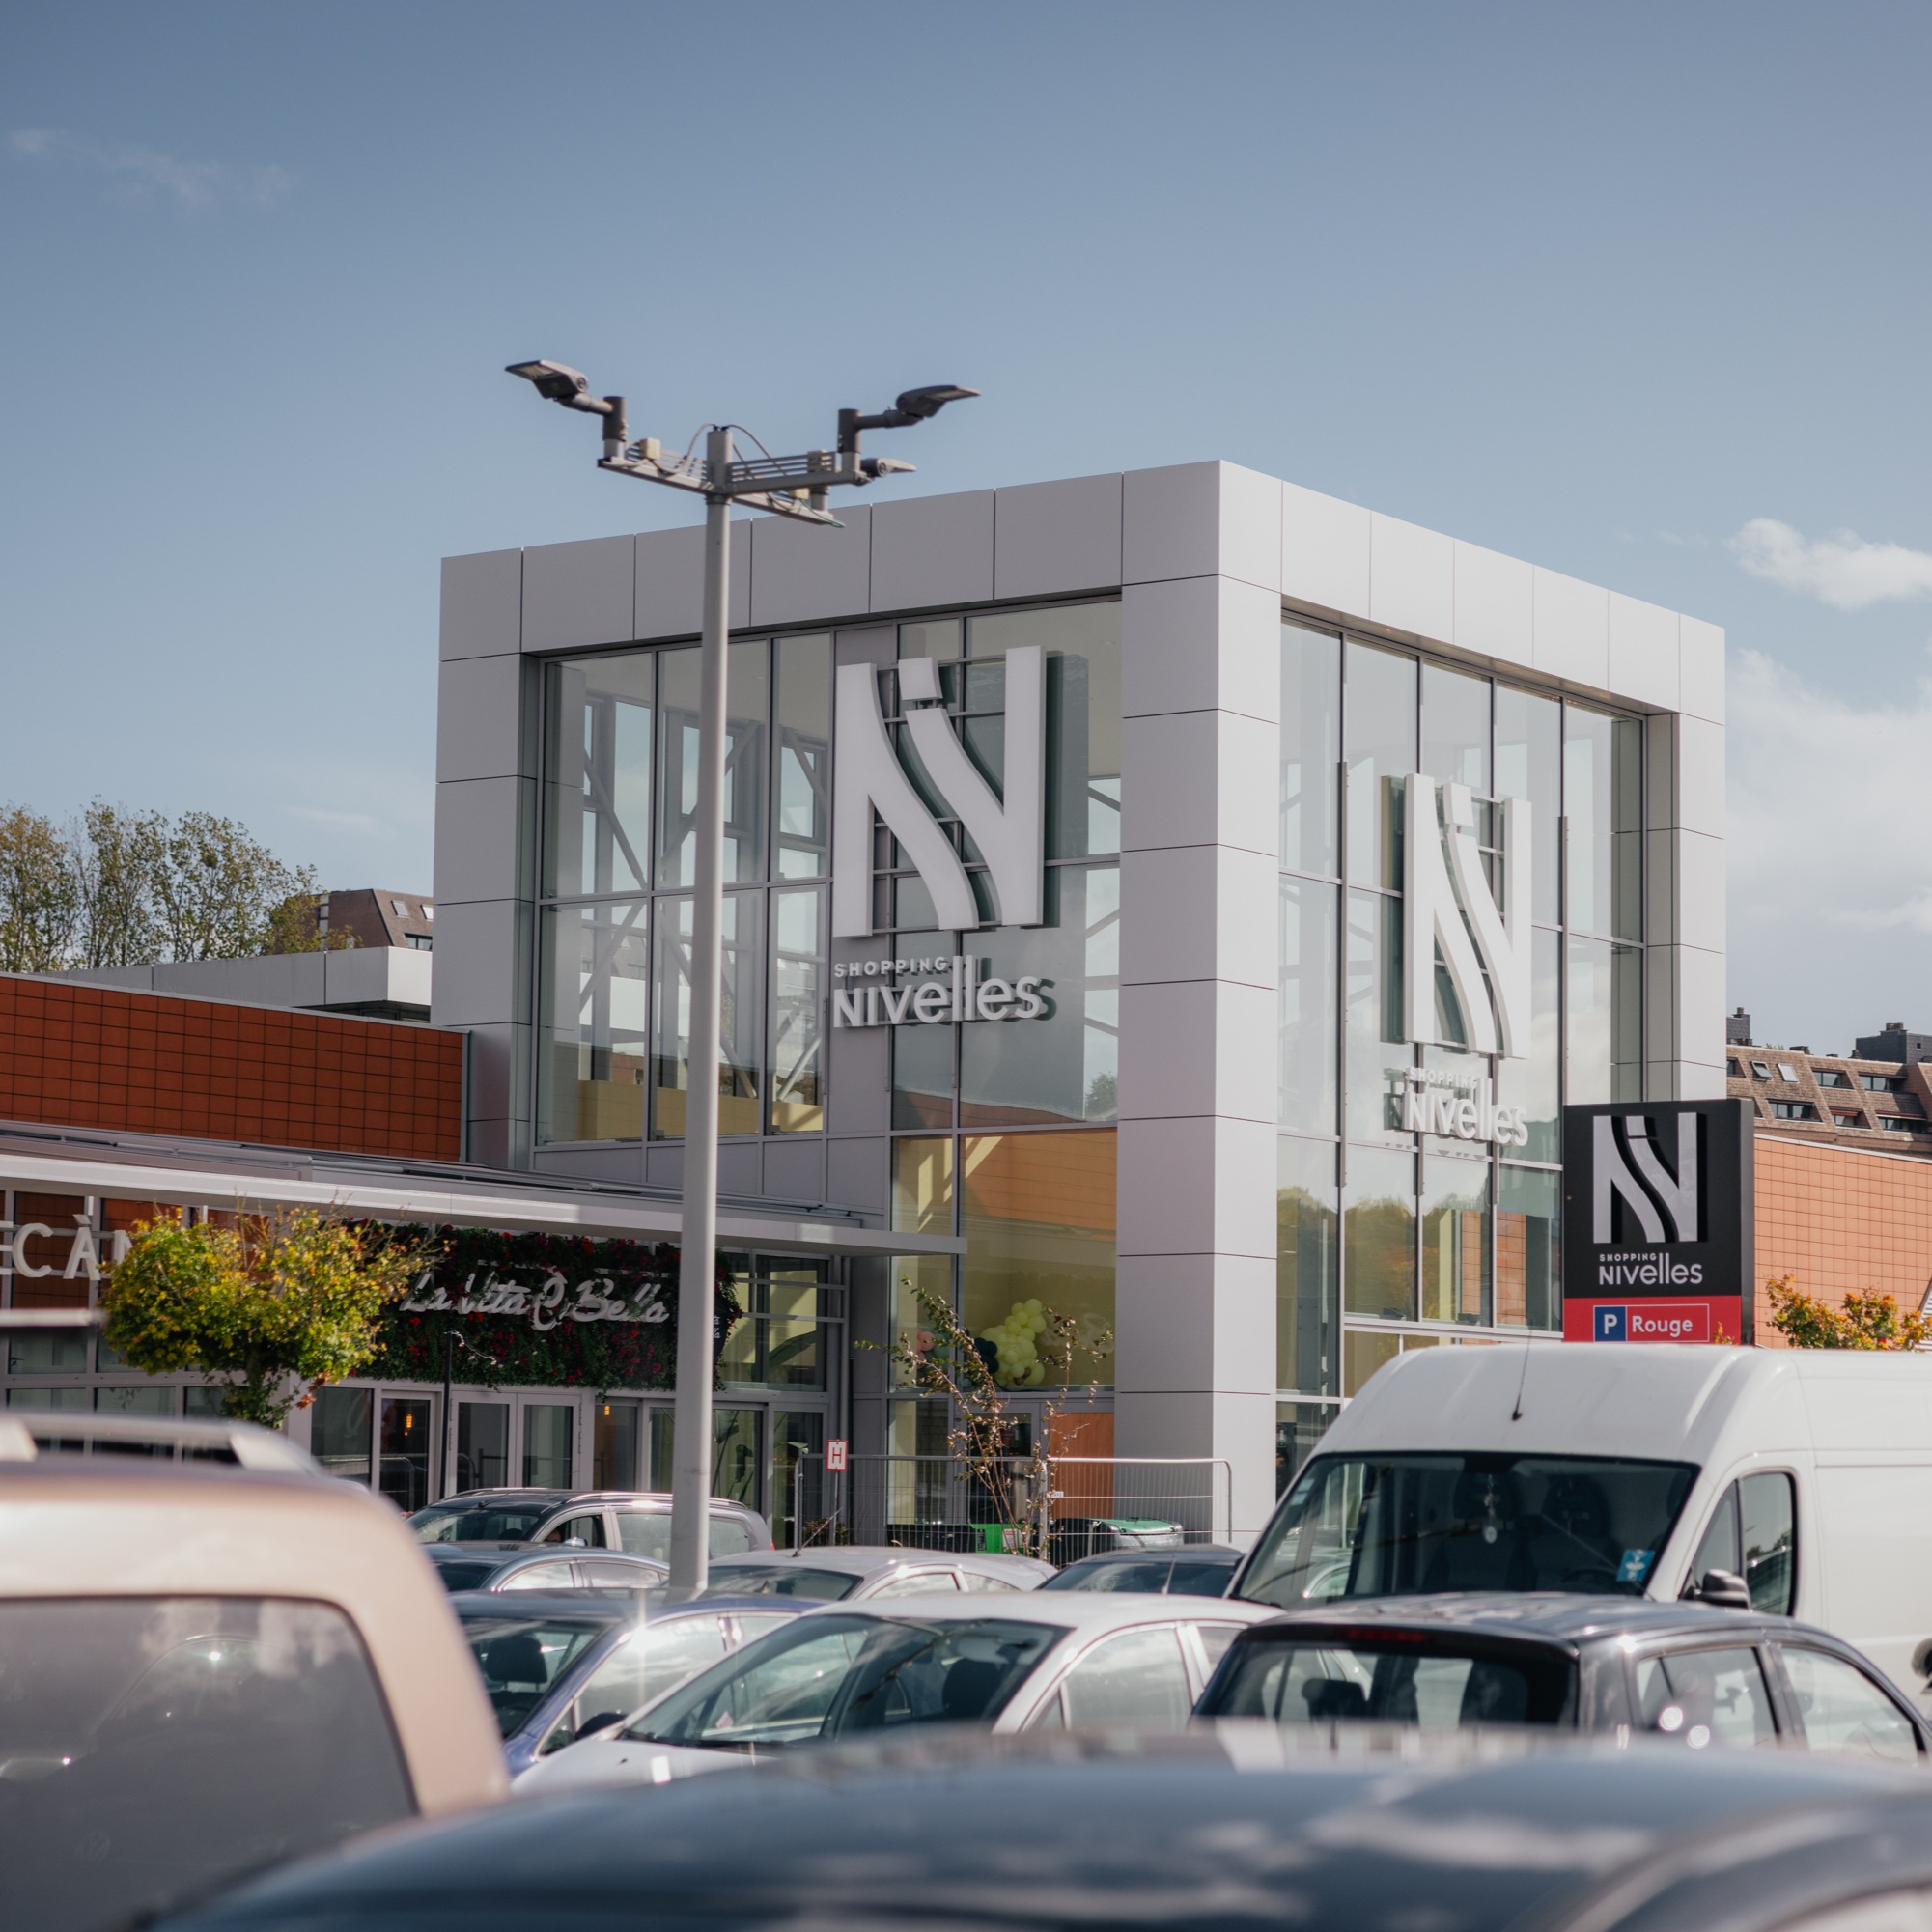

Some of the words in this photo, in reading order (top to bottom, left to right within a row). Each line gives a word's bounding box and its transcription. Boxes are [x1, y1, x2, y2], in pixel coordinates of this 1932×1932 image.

[834, 956, 950, 978] SHOPPING
[1407, 1066, 1477, 1089] SHOPPING
[1599, 1253, 1658, 1263] SHOPPING
[1603, 1314, 1618, 1334] P
[1632, 1315, 1694, 1338] Rouge
